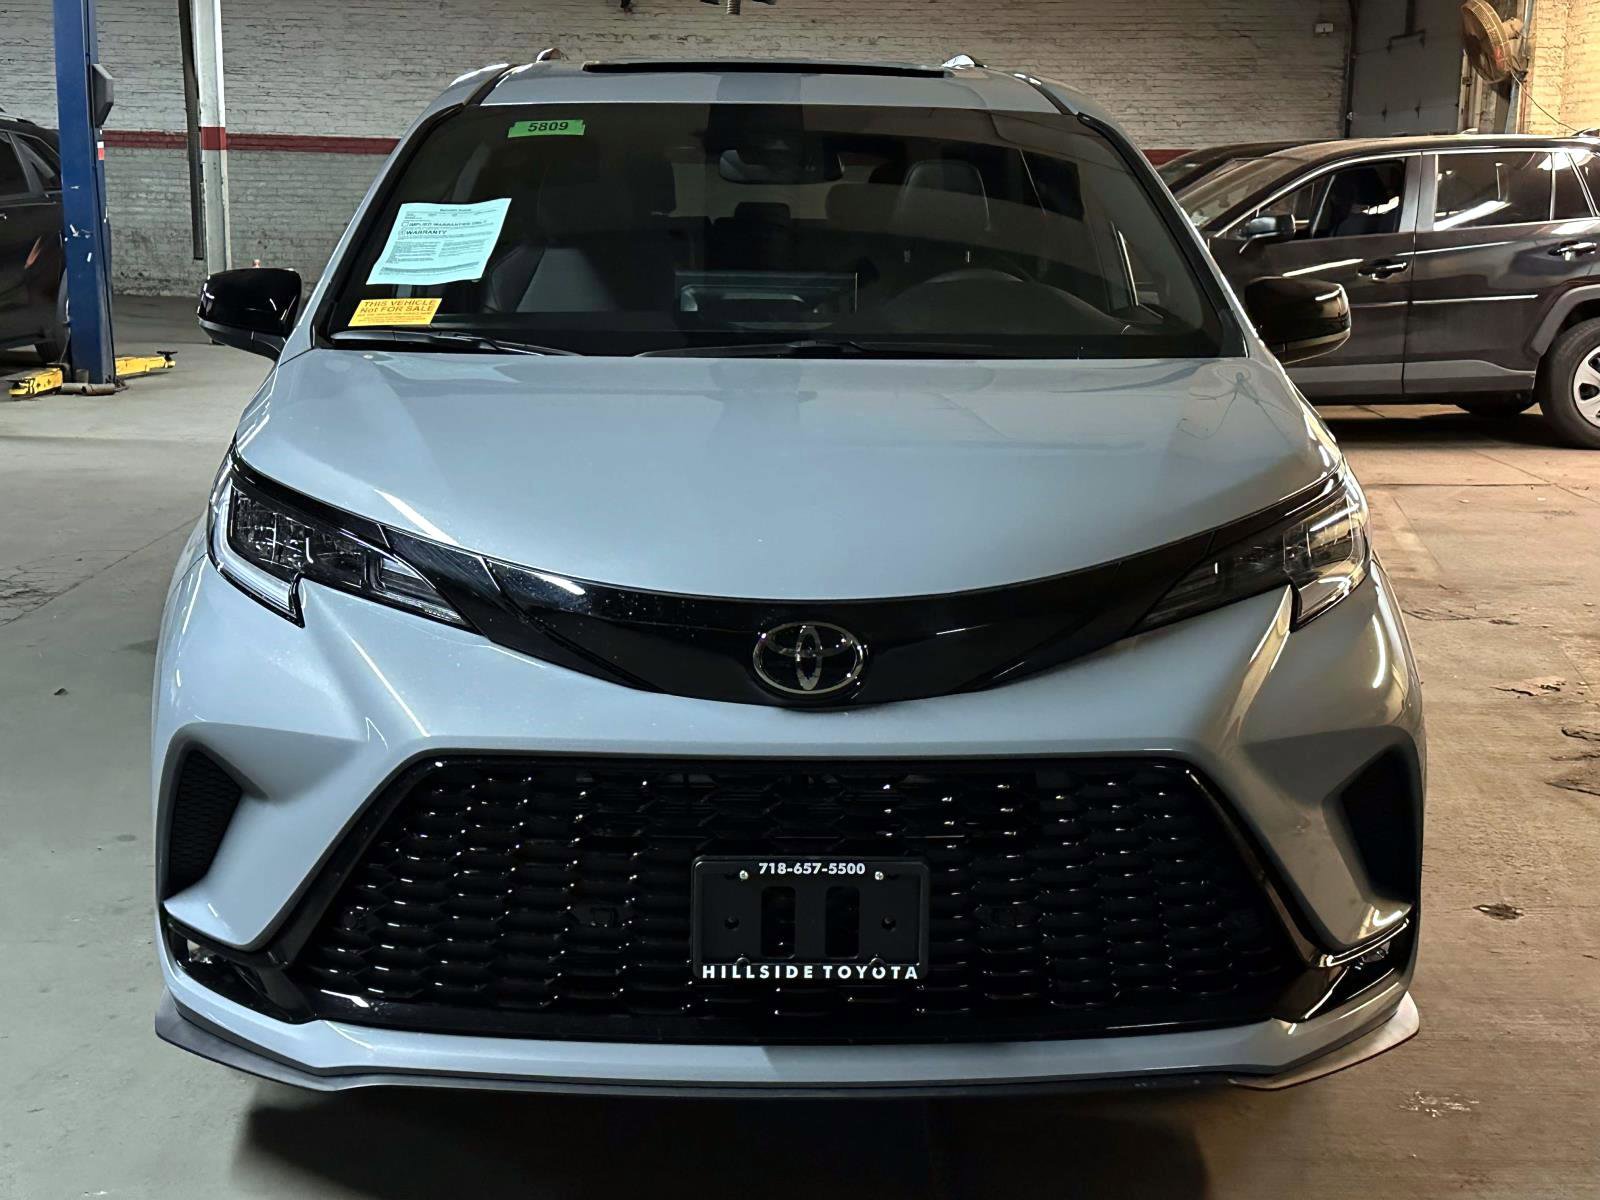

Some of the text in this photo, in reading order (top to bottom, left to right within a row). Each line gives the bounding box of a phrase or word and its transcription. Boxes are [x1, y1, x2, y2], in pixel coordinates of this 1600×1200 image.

[528, 121, 569, 132] 5809
[758, 862, 866, 875] 718-657-5500
[702, 965, 918, 979] HILLSIDE TOYOTA
